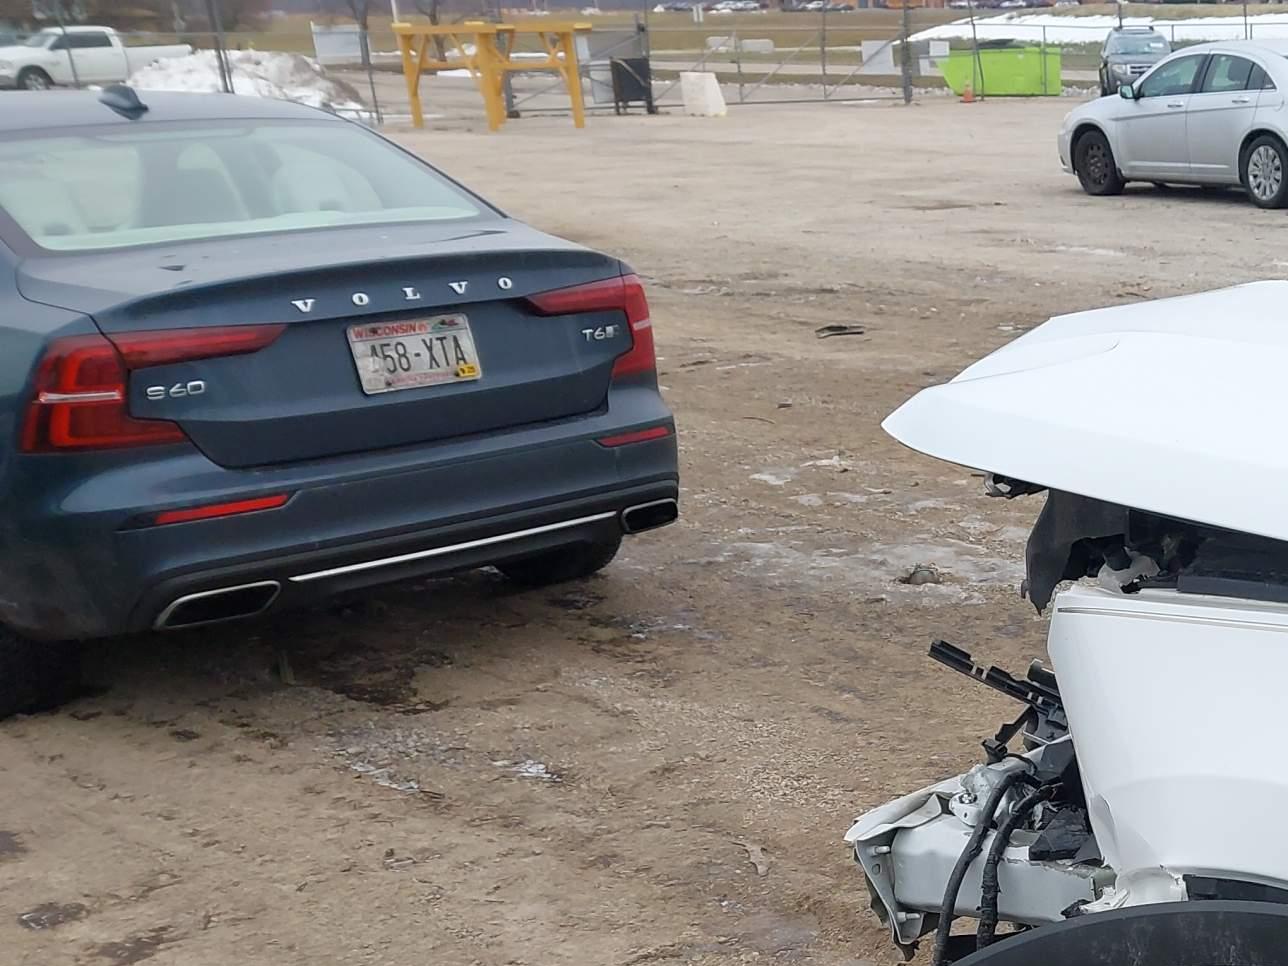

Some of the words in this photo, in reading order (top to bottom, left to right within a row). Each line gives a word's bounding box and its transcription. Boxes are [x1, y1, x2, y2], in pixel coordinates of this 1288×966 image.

[291, 276, 513, 313] VOLVO
[352, 322, 417, 338] WISCONSIN
[146, 380, 205, 400] S60
